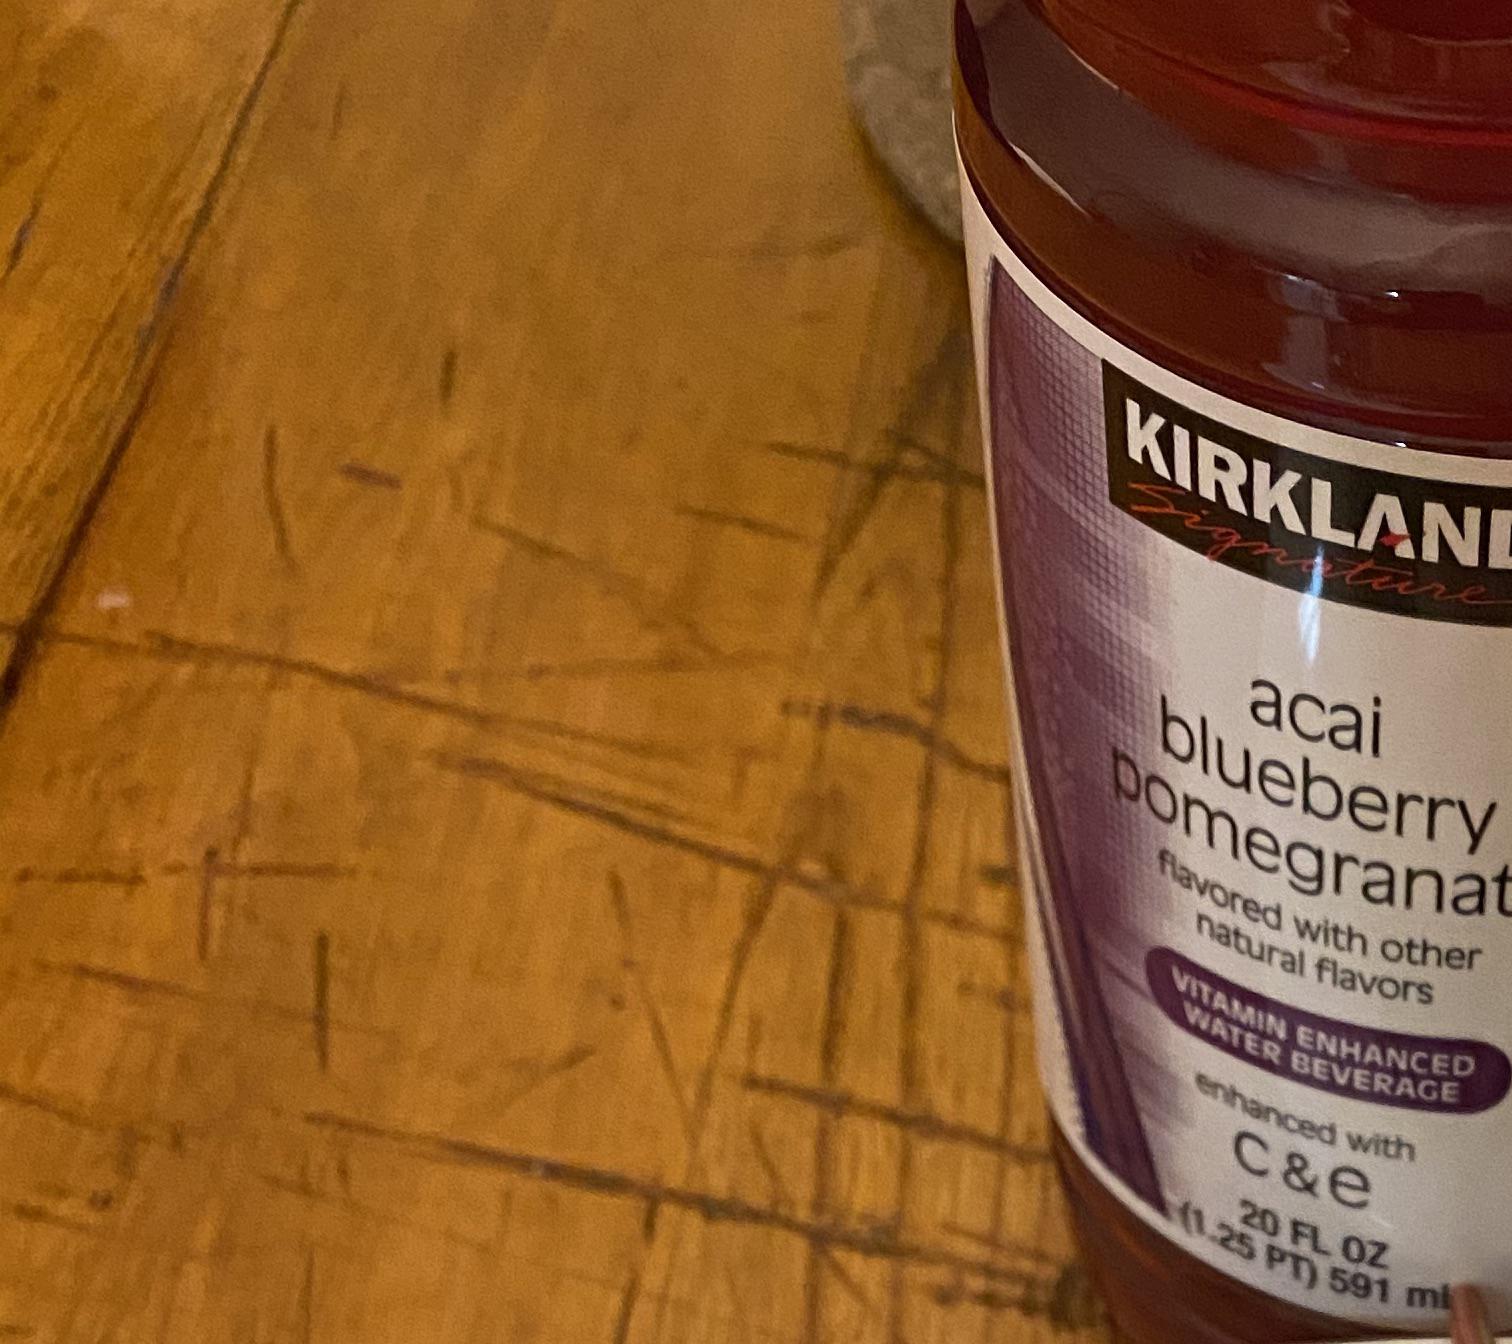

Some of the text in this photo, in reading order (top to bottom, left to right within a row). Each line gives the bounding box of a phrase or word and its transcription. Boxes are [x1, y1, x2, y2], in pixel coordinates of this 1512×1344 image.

[1250, 678, 1382, 759] acai
[1160, 693, 1498, 855] blueberry
[1158, 849, 1482, 971] flavored with other
[1197, 912, 1435, 1006] natural flavors
[1170, 964, 1477, 1077] VITAMIN ENHANCED
[1183, 1002, 1462, 1103] WATER BEVERAGE
[1195, 1072, 1417, 1163] enhanced with
[1179, 1201, 1256, 1261] (1.25
[1266, 1243, 1318, 1290] PT)
[1329, 1266, 1390, 1303] 591
[1239, 1199, 1389, 1269] 20 FL OZ
